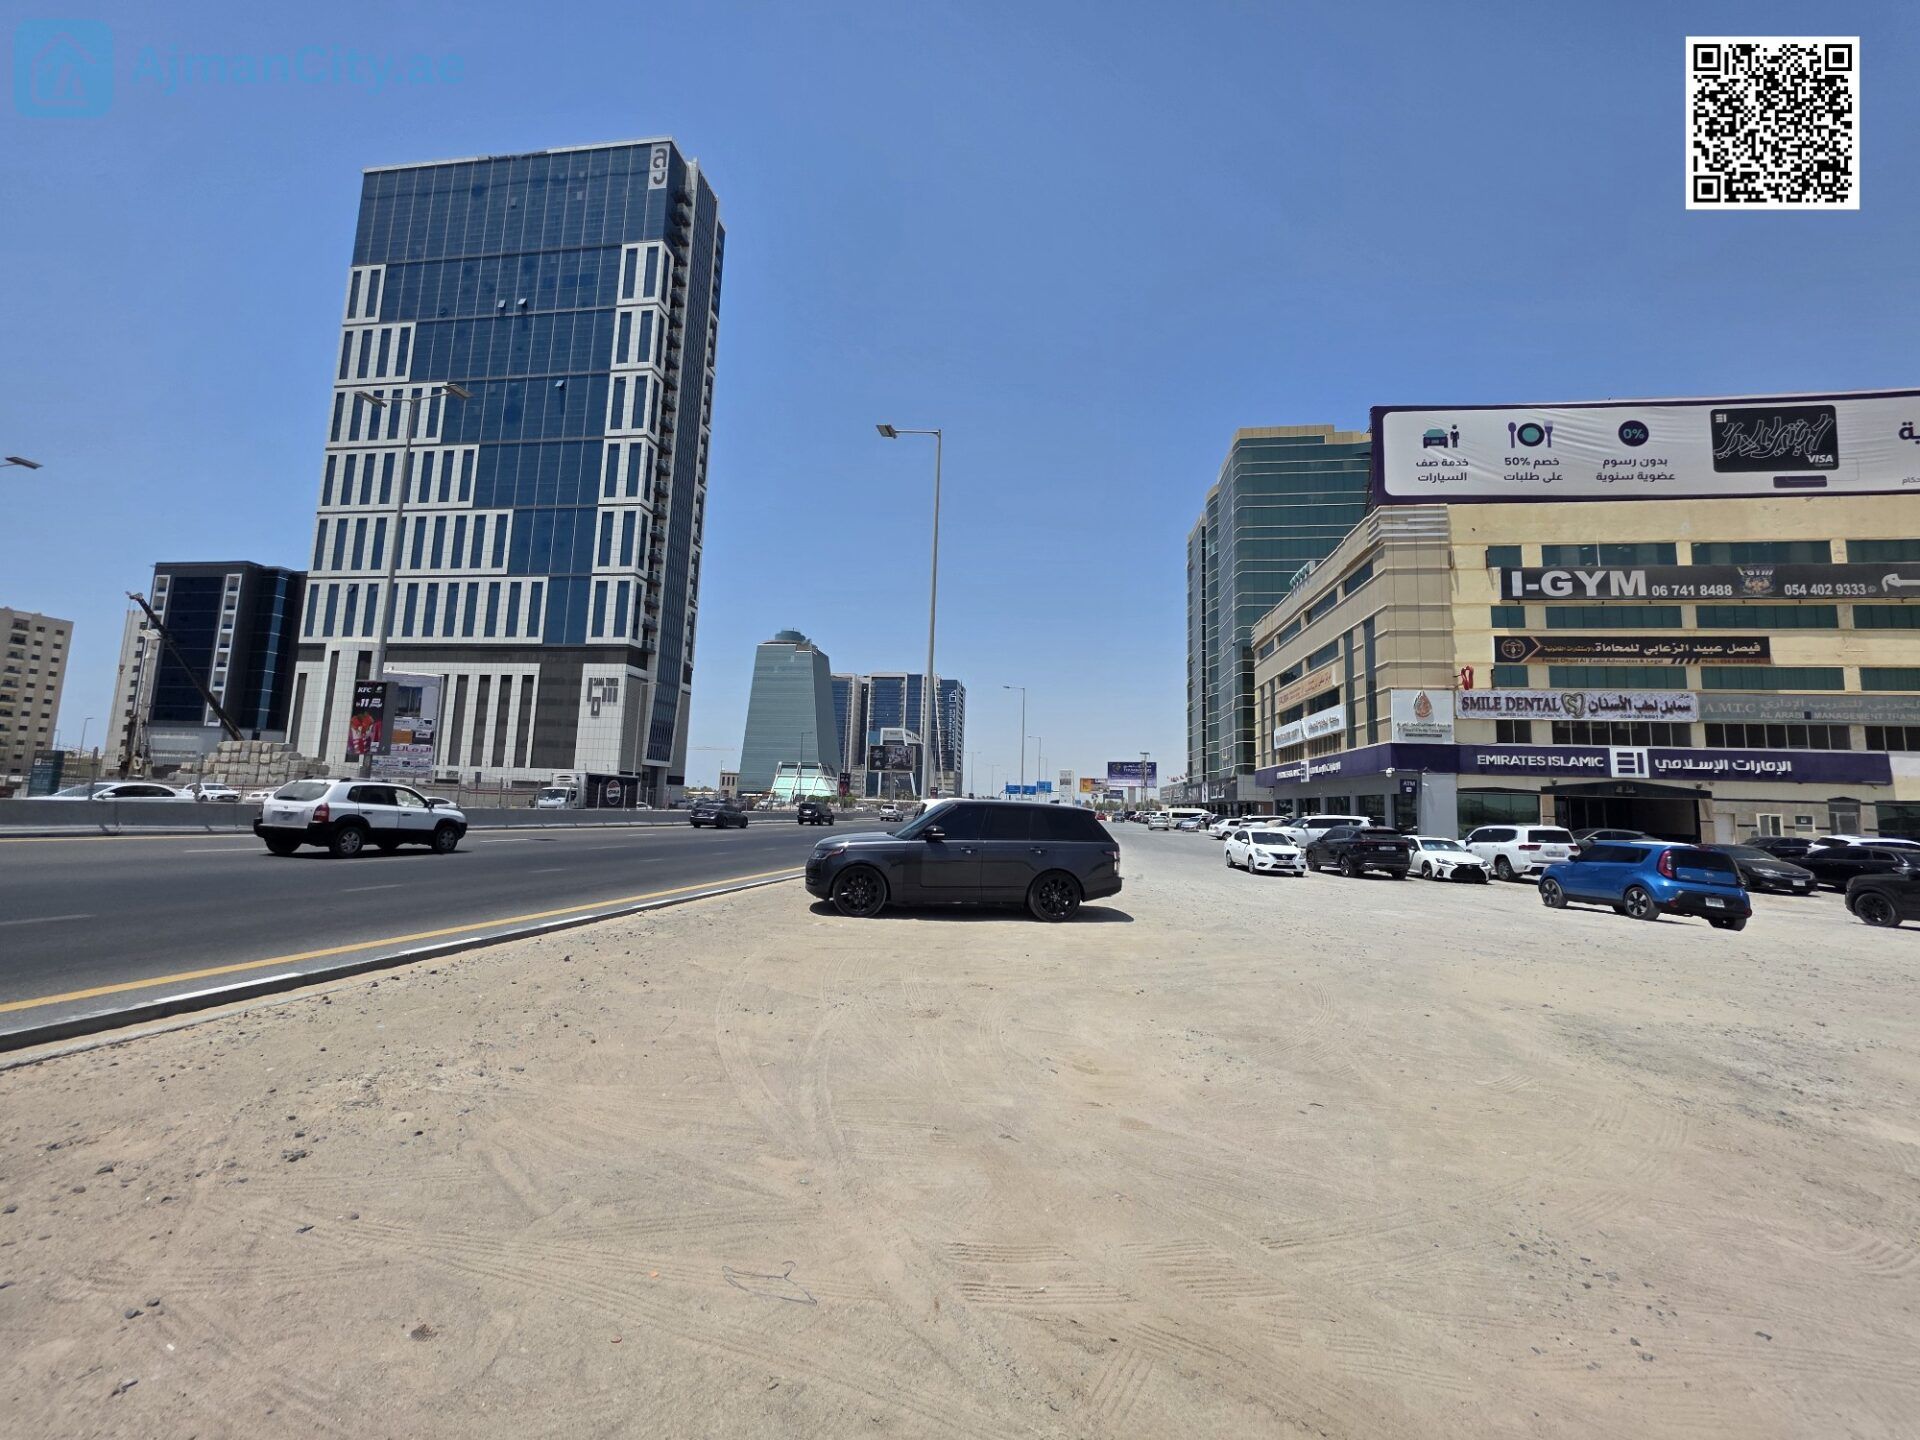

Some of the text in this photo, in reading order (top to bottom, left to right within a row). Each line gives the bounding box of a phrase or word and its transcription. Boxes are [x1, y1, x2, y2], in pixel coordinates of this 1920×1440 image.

[1622, 428, 1645, 439] 0%
[1416, 457, 1469, 468] خدمة صف
[1533, 457, 1560, 469] خصم
[1602, 458, 1668, 469] بدون رسوم
[1807, 454, 1834, 464] VISA
[1417, 472, 1468, 482] السيارات
[1503, 472, 1564, 484] على طلبات
[1596, 471, 1676, 483] عضوية سنوية
[1511, 570, 1866, 597] I-GYM 06 741 8488 054 402 9333
[1594, 642, 1640, 652] للمحاماة
[1693, 643, 1723, 652] عبيد
[1726, 643, 1761, 654] فيصل
[1462, 696, 1502, 712] SMILE
[1505, 696, 1560, 712] DENTAL
[1588, 694, 1692, 714] سمايل لطب الأسنان
[1477, 754, 1546, 766] EMIRATES
[1548, 755, 1604, 768] ISLAMIC
[1654, 758, 1792, 774] الإمارات الإسلامي
